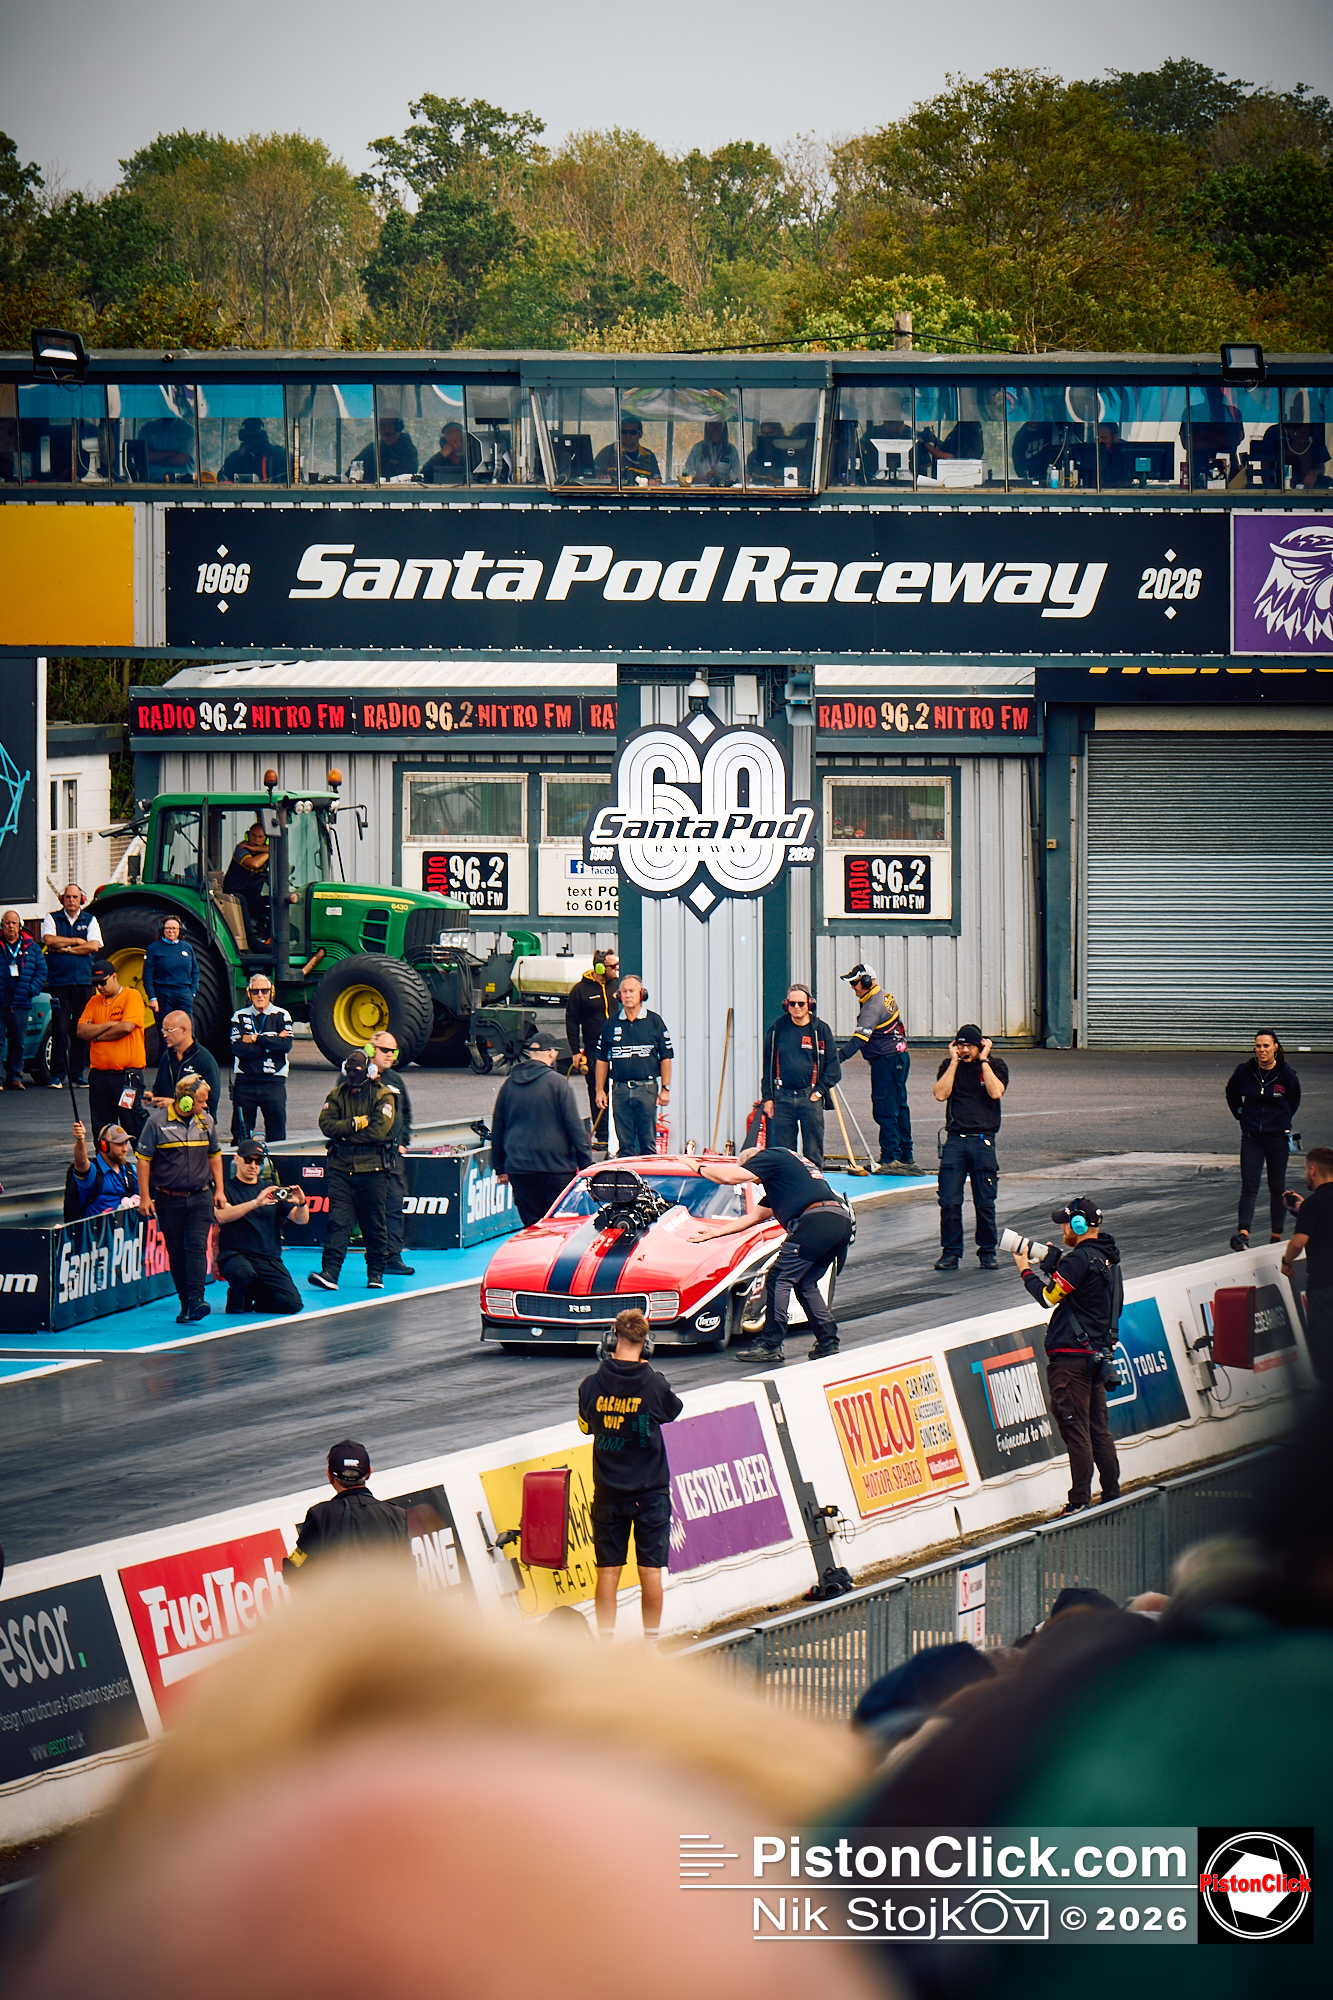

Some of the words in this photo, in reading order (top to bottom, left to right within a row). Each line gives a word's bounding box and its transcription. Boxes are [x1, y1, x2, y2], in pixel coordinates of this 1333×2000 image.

[196, 562, 251, 595] 1966
[288, 543, 544, 600] Santa
[545, 545, 725, 602] Pod
[722, 546, 1108, 619] Raceway
[1137, 567, 1203, 600] 2026
[138, 702, 196, 731] RADIO
[199, 701, 248, 732] 96.2
[251, 704, 311, 731] NITRO
[316, 703, 345, 730] FM
[363, 702, 421, 730] RADIO
[425, 701, 474, 731] 96.2
[477, 703, 538, 729] NITRO
[544, 702, 572, 729] FM
[590, 702, 617, 730] RA
[818, 702, 877, 731] RADIO
[881, 702, 930, 732] 96.2
[934, 705, 994, 730] NITRO
[1001, 705, 1029, 730] FM
[596, 813, 719, 839] Santa
[722, 813, 808, 839] Pod
[589, 846, 615, 861] 1966
[655, 845, 748, 853] RACEWAY
[787, 846, 816, 862] 2026
[426, 856, 449, 895] ADIO
[449, 855, 505, 891] 96.2
[591, 865, 618, 875] faceb
[848, 859, 872, 910] RADIO
[871, 858, 926, 893] 96.2
[487, 890, 504, 906] FM
[566, 900, 579, 911] to
[567, 886, 593, 897] text
[872, 894, 908, 910] NITRO
[908, 893, 925, 910] FM
[467, 1167, 506, 1224] Santa
[58, 1241, 110, 1305] Santa
[111, 1222, 144, 1288] Pod
[145, 1218, 171, 1278] Ra
[568, 1304, 592, 1313] RS
[1133, 1350, 1168, 1377] TOOLS
[905, 1375, 921, 1400] CAR
[919, 1372, 938, 1396] PARTS
[832, 1382, 916, 1469] WILCO
[920, 1425, 938, 1449] SINCE
[675, 1462, 743, 1521] KESTREL
[733, 1453, 778, 1505] BEER
[862, 1469, 895, 1500] MOTOR
[892, 1458, 923, 1490] SPARES
[138, 1556, 292, 1657] FuelTech
